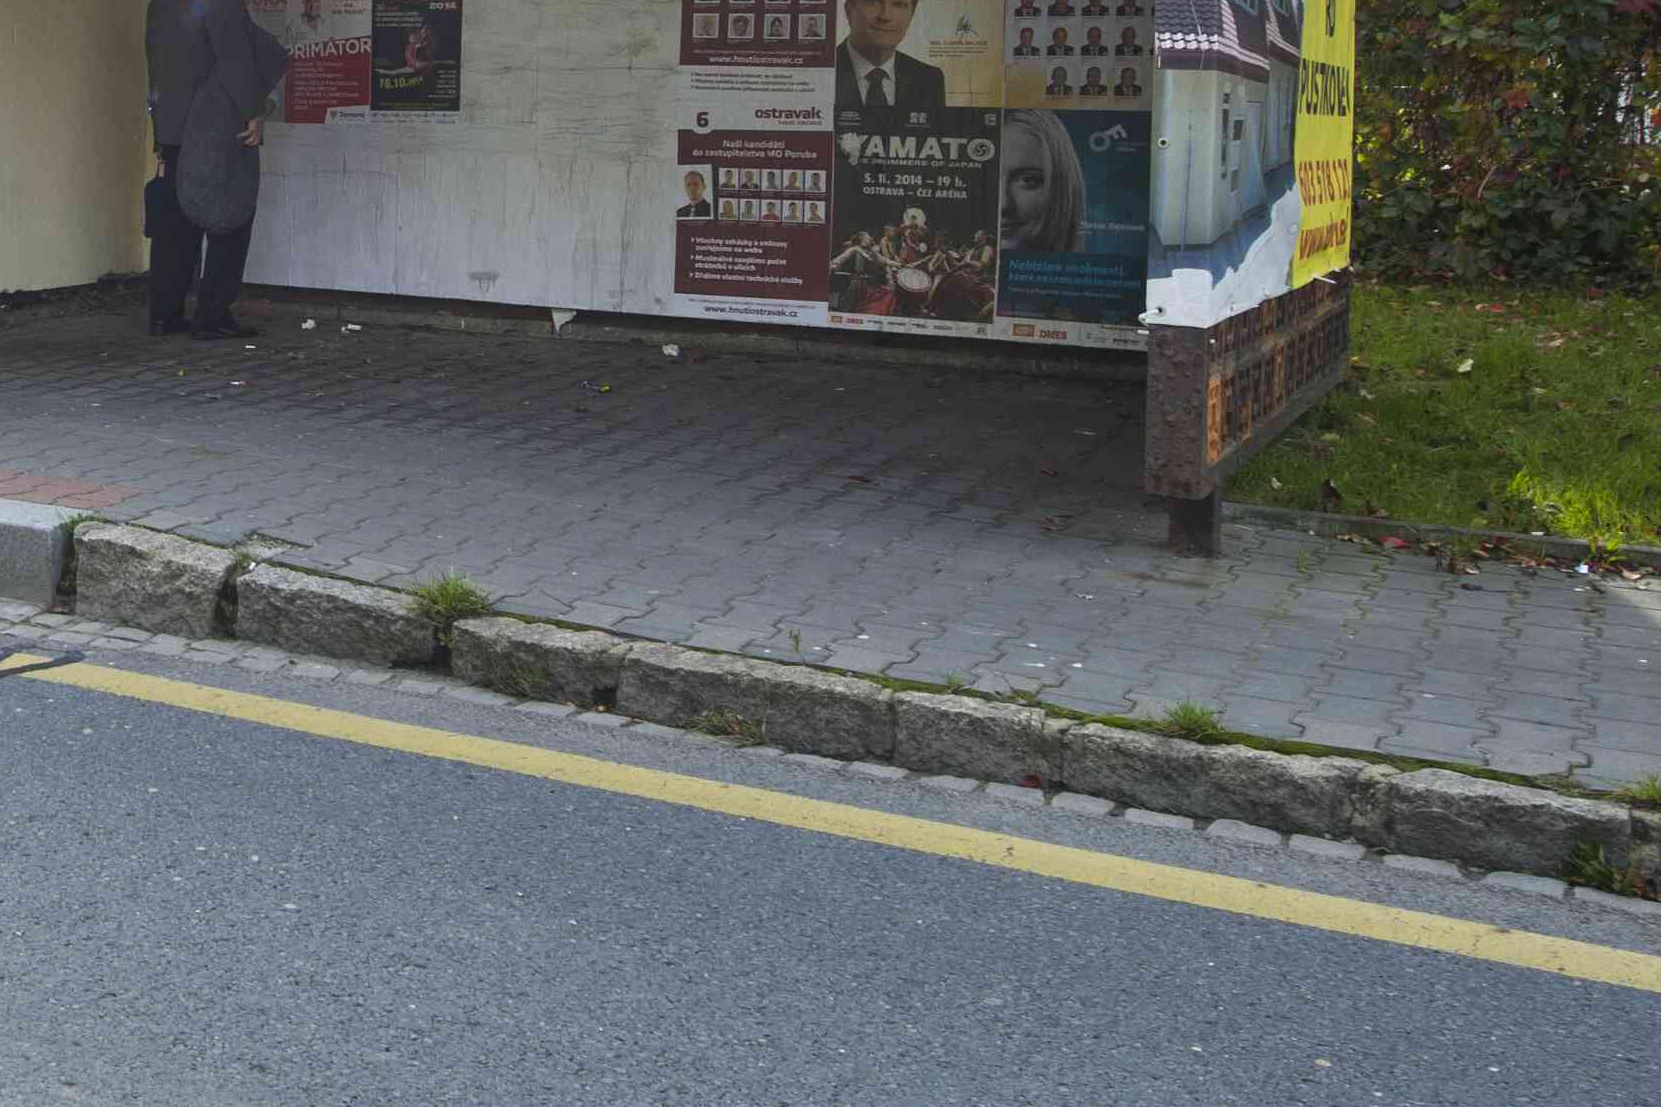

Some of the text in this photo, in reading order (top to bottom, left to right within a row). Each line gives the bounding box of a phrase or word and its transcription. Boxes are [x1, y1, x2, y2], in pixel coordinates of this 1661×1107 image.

[696, 111, 709, 128] 6
[755, 107, 821, 120] ostravak
[863, 173, 875, 184] 5.
[894, 174, 923, 185] 2014
[938, 176, 950, 187] 19
[863, 186, 905, 197] OSTRAVA
